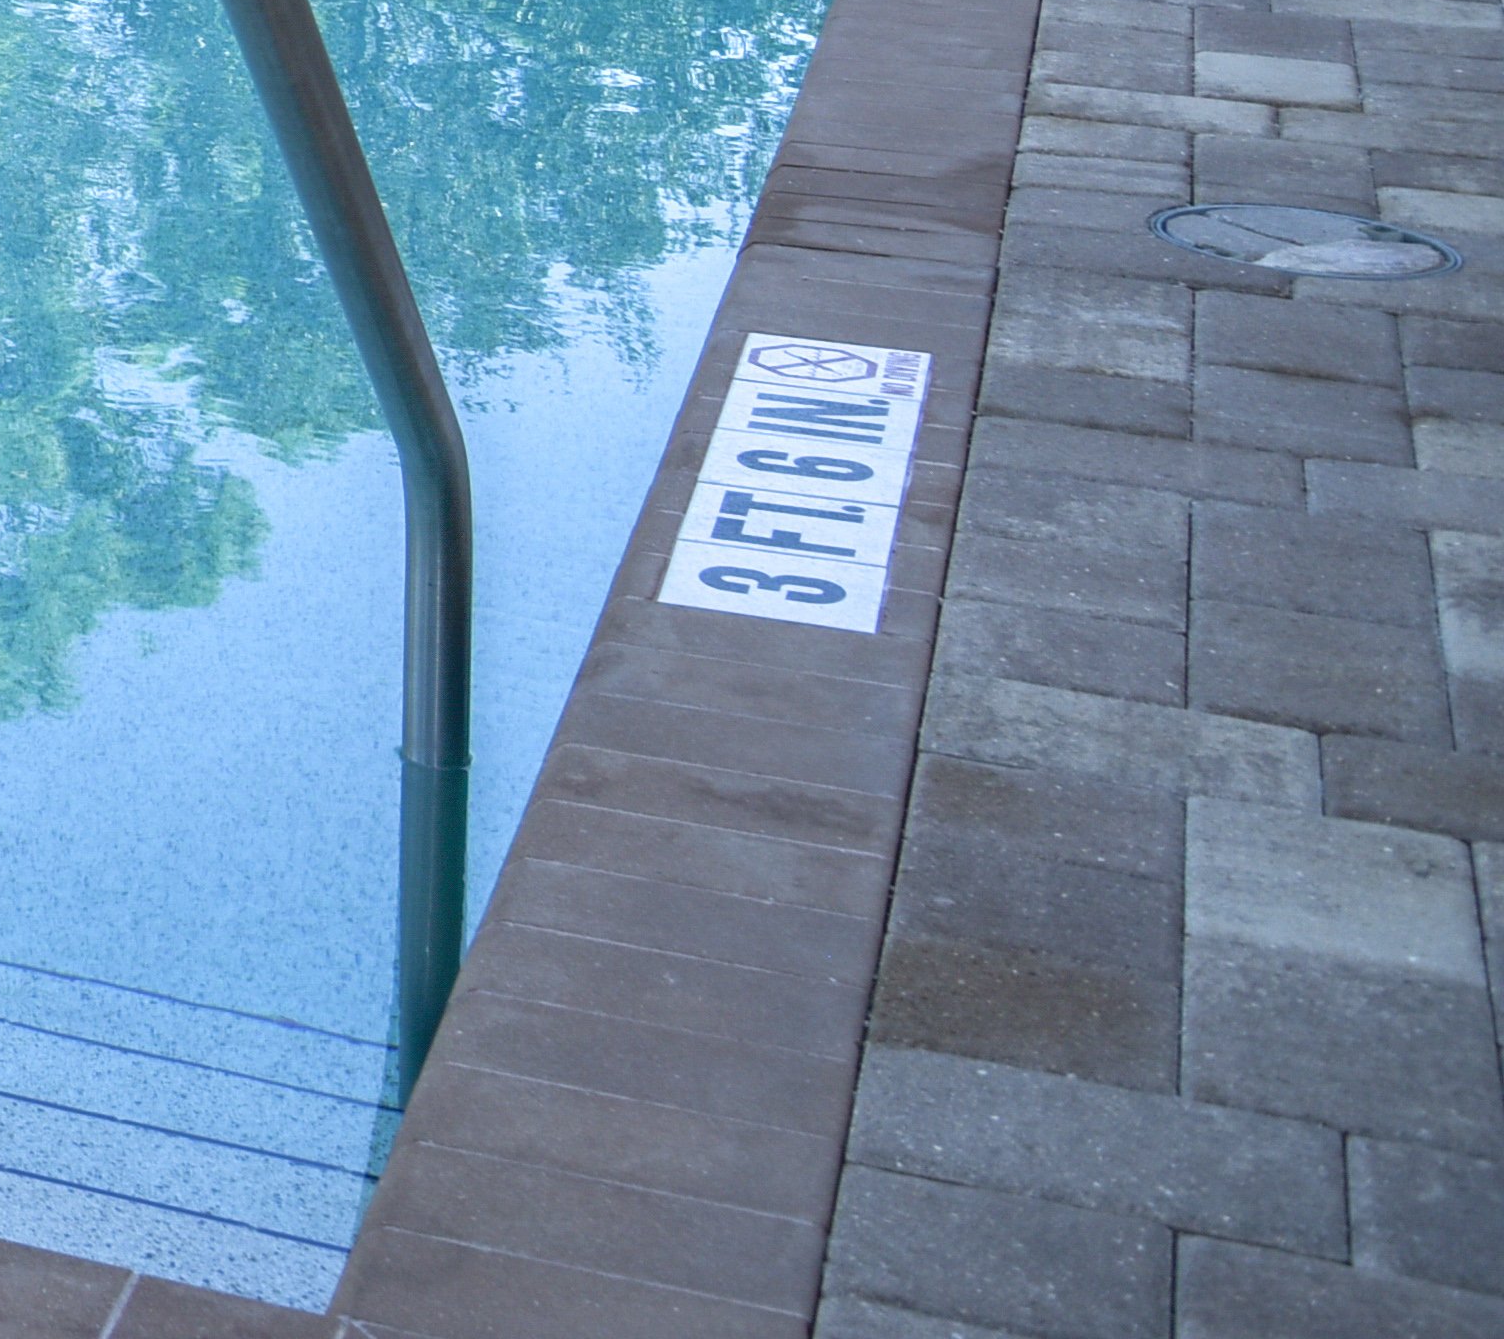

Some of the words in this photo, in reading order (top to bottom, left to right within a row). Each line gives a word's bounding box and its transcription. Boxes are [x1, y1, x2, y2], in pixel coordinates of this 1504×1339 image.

[747, 392, 892, 445] IN.
[737, 449, 874, 482] 6
[710, 489, 866, 558] FT.
[698, 565, 847, 605] 3
